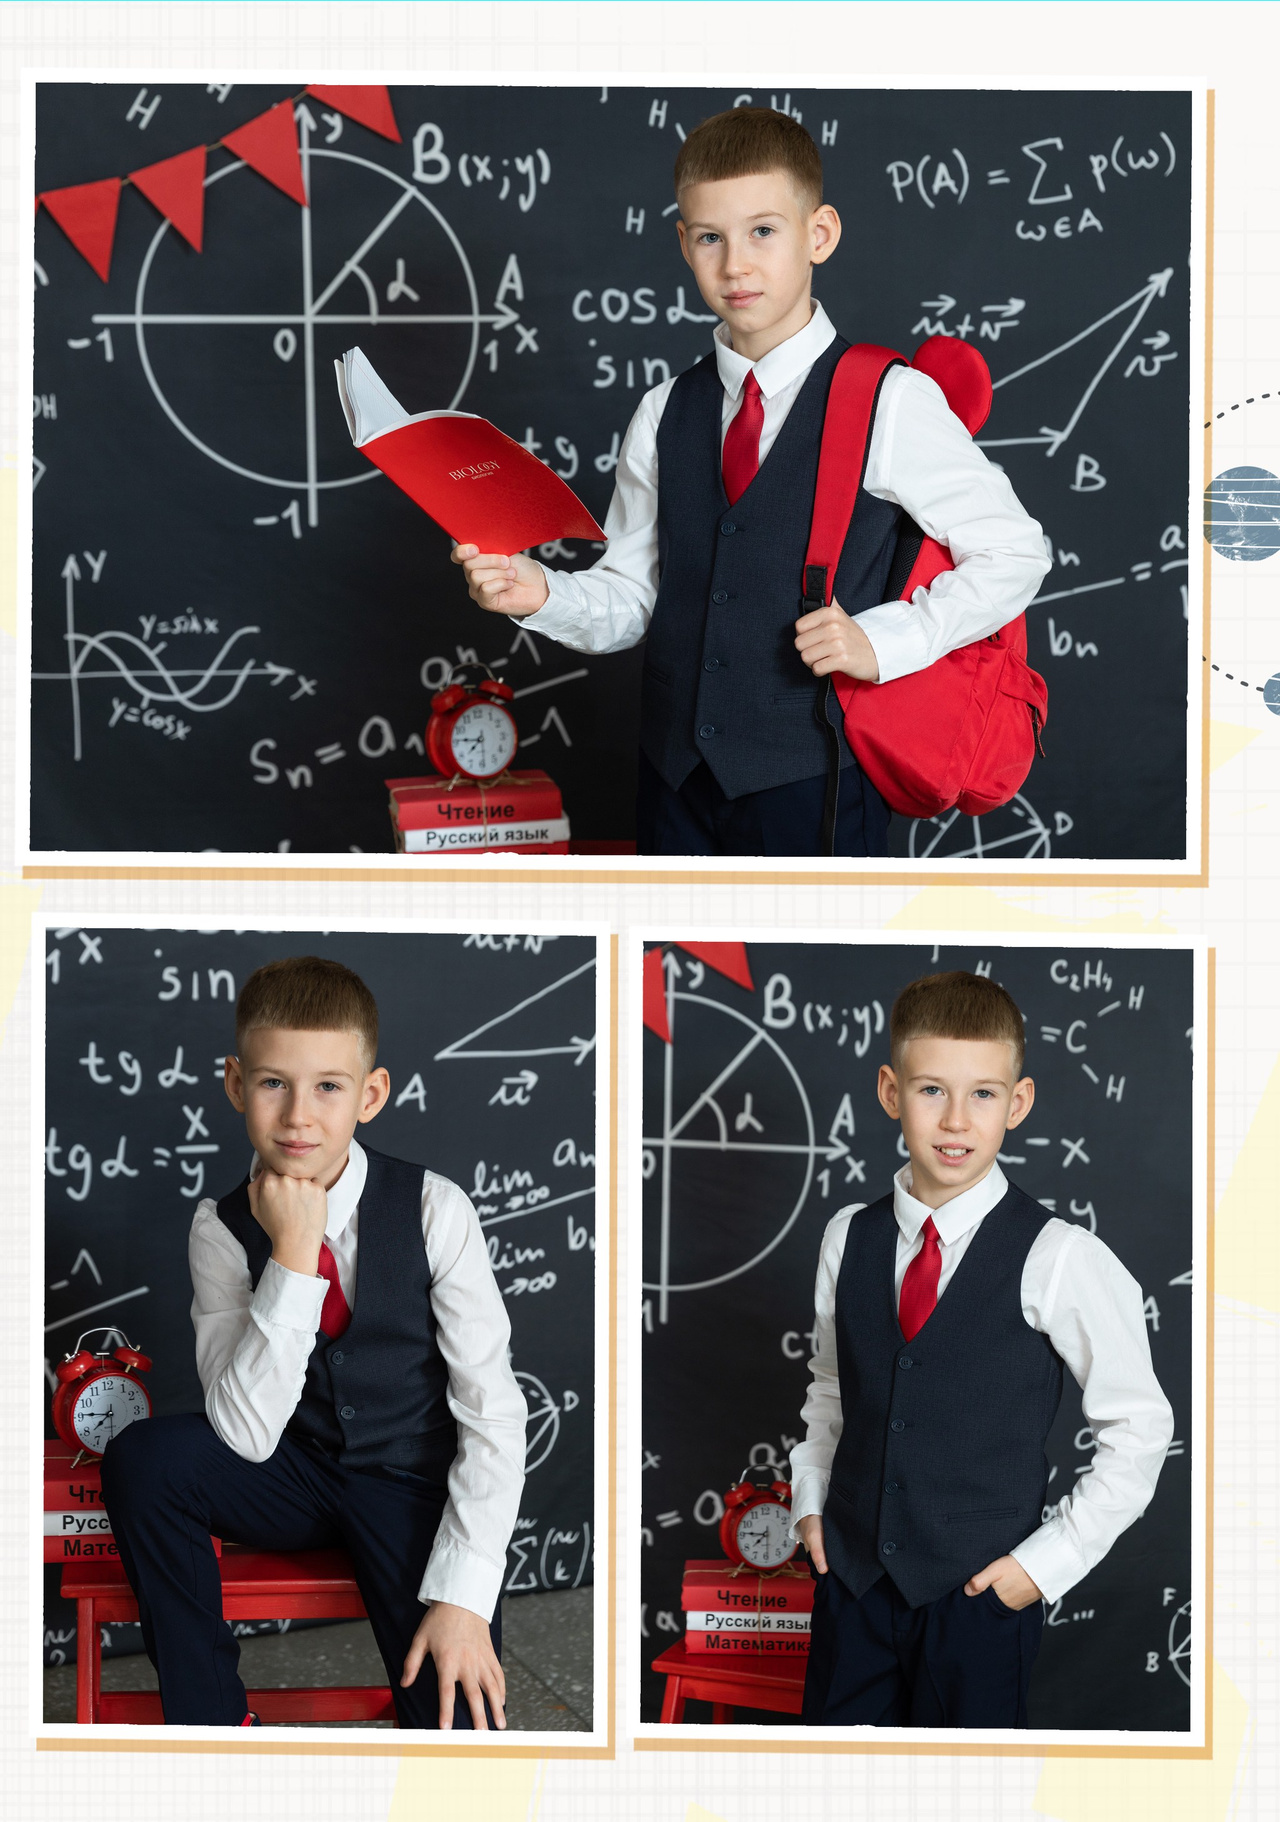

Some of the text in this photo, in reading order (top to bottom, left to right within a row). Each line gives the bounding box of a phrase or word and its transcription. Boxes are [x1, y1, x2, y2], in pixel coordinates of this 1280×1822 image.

[448, 460, 500, 481] BIOLOGY
[438, 803, 515, 820] Чтение
[426, 828, 549, 847] Русский язык
[90, 1387, 99, 1396] 11
[102, 1380, 113, 1391] 12
[121, 1383, 126, 1394] 1
[80, 1398, 92, 1408] 10
[128, 1391, 135, 1400] 2
[134, 1405, 140, 1415] 3
[62, 1514, 109, 1533] Русс
[64, 1539, 118, 1556] Мате
[717, 1590, 787, 1608] Чтение
[705, 1614, 811, 1630] Русский язы
